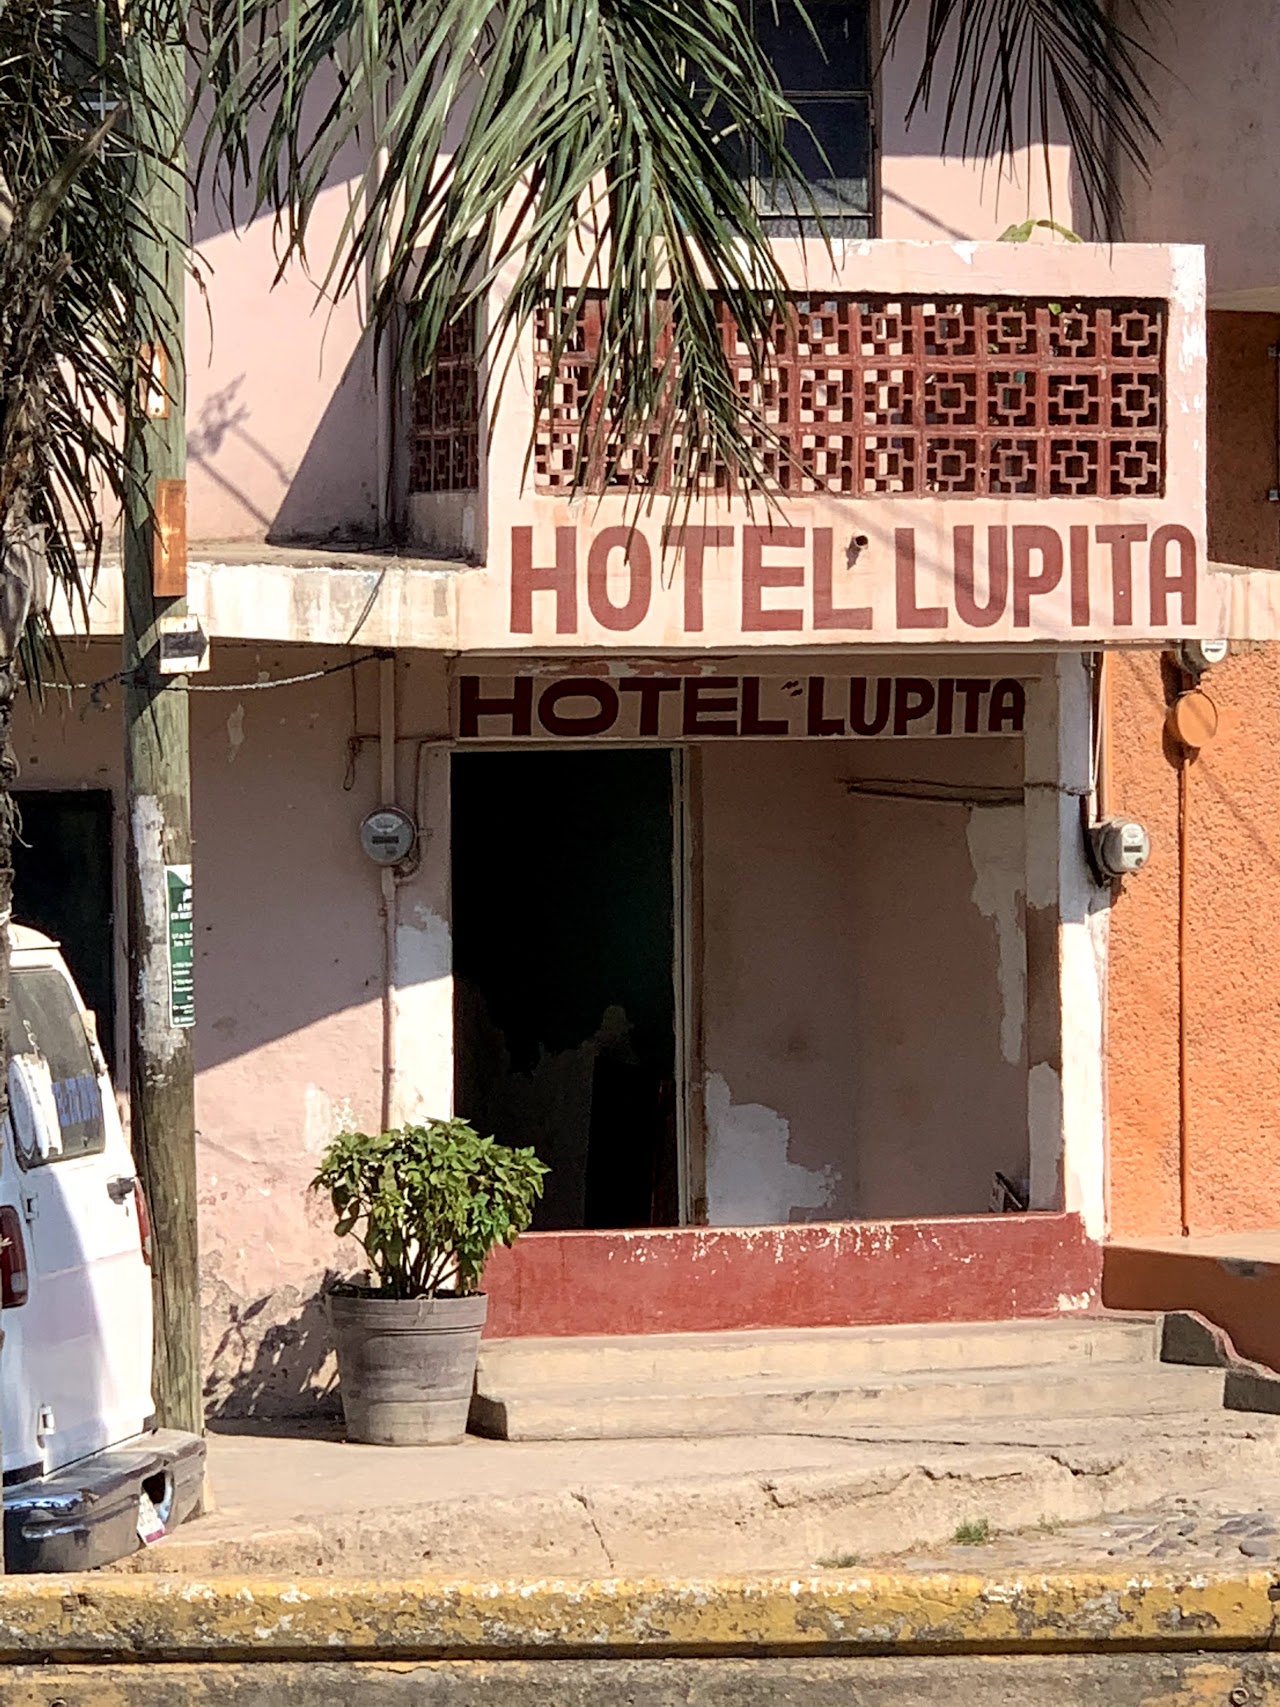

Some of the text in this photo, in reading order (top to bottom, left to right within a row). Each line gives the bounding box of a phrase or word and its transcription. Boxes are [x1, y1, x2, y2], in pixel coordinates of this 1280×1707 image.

[509, 523, 1197, 634] HOTEL LUPITA
[459, 675, 789, 737] HOTEL
